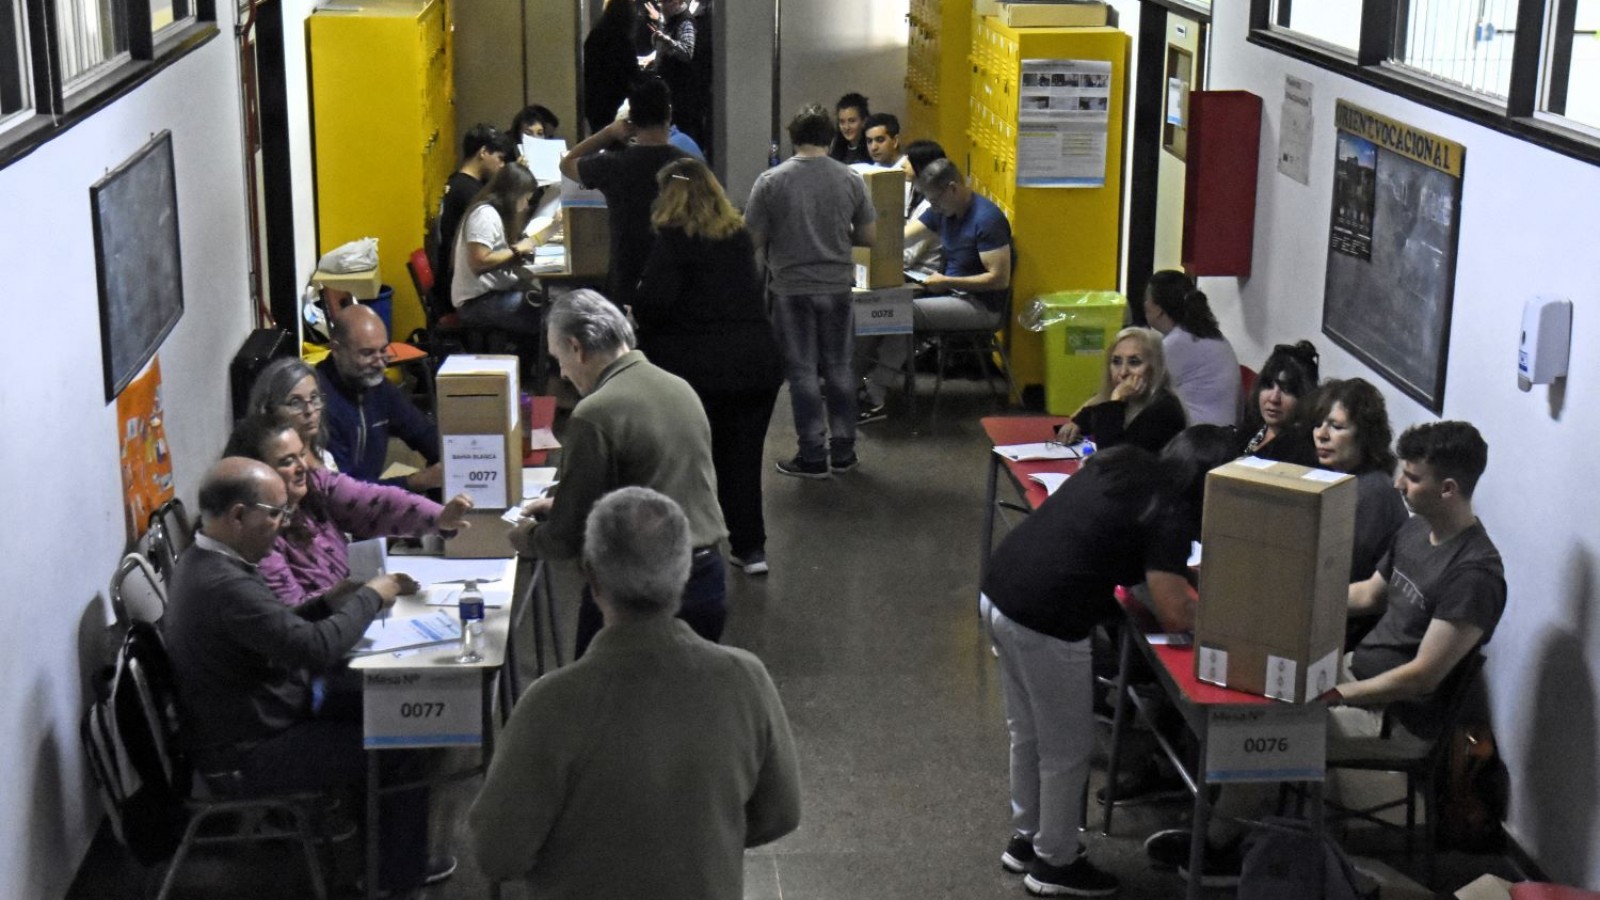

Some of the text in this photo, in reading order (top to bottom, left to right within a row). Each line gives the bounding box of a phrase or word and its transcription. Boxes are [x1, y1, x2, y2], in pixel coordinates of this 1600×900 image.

[469, 471, 498, 481] 0077
[401, 702, 446, 718] 0077
[1244, 737, 1288, 753] 0076
